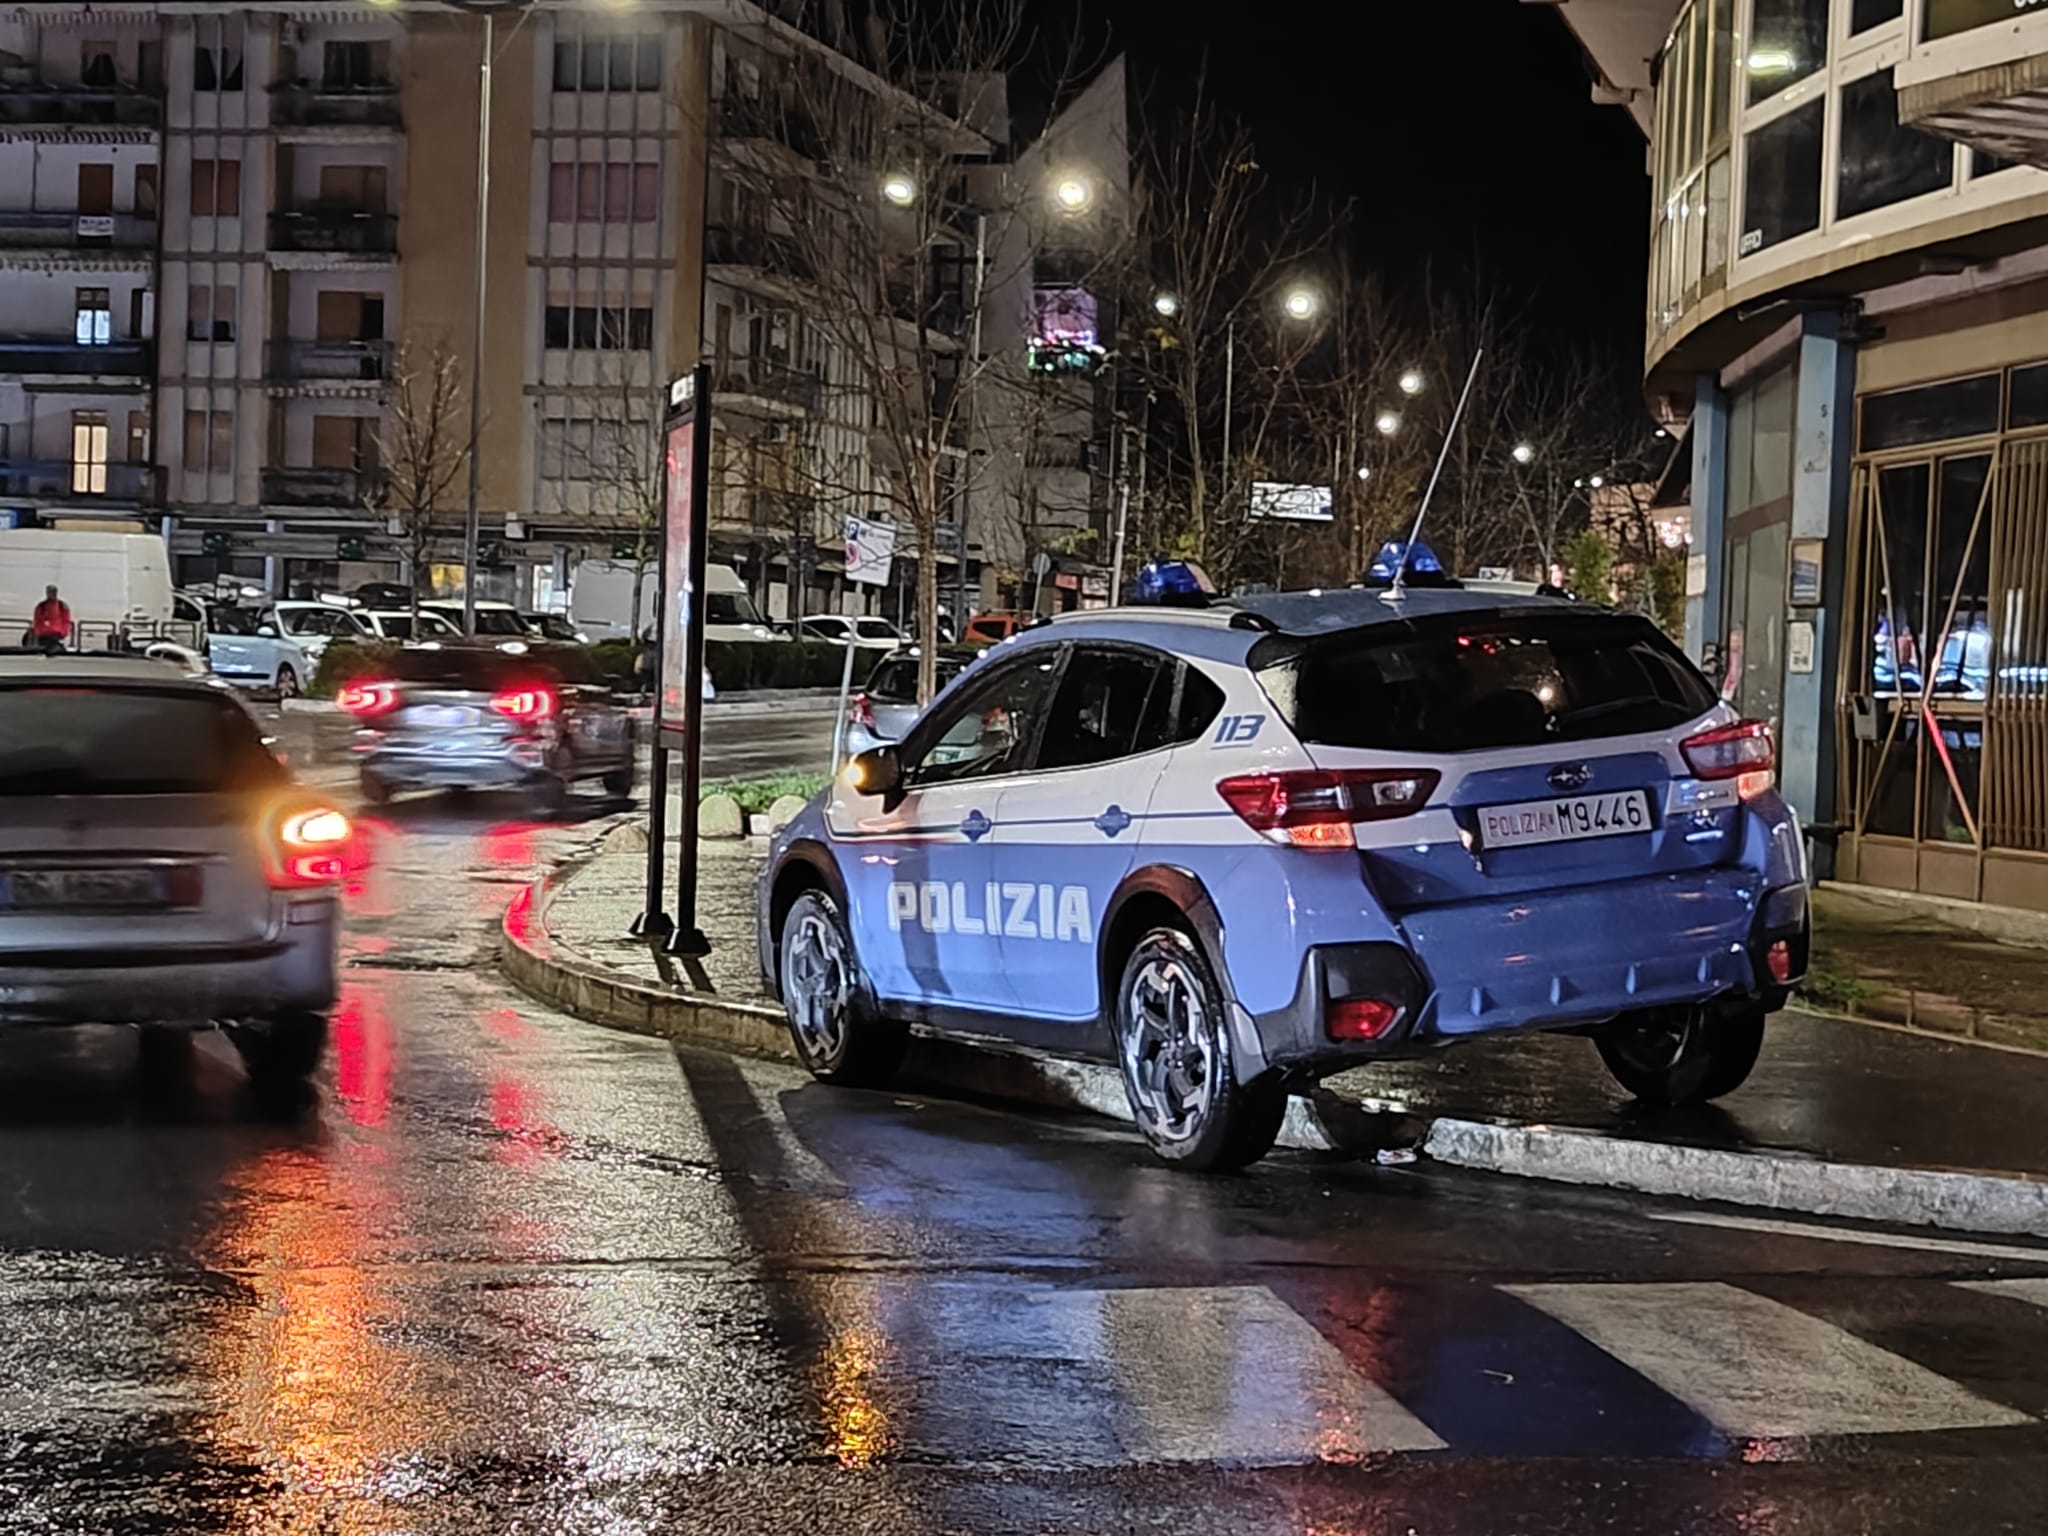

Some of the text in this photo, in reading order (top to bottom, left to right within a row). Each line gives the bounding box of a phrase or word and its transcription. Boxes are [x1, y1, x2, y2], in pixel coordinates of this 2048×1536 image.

[1214, 714, 1266, 743] 113
[1488, 795, 1642, 838] POLIZIA M9446
[887, 881, 1093, 943] POLIZIA
